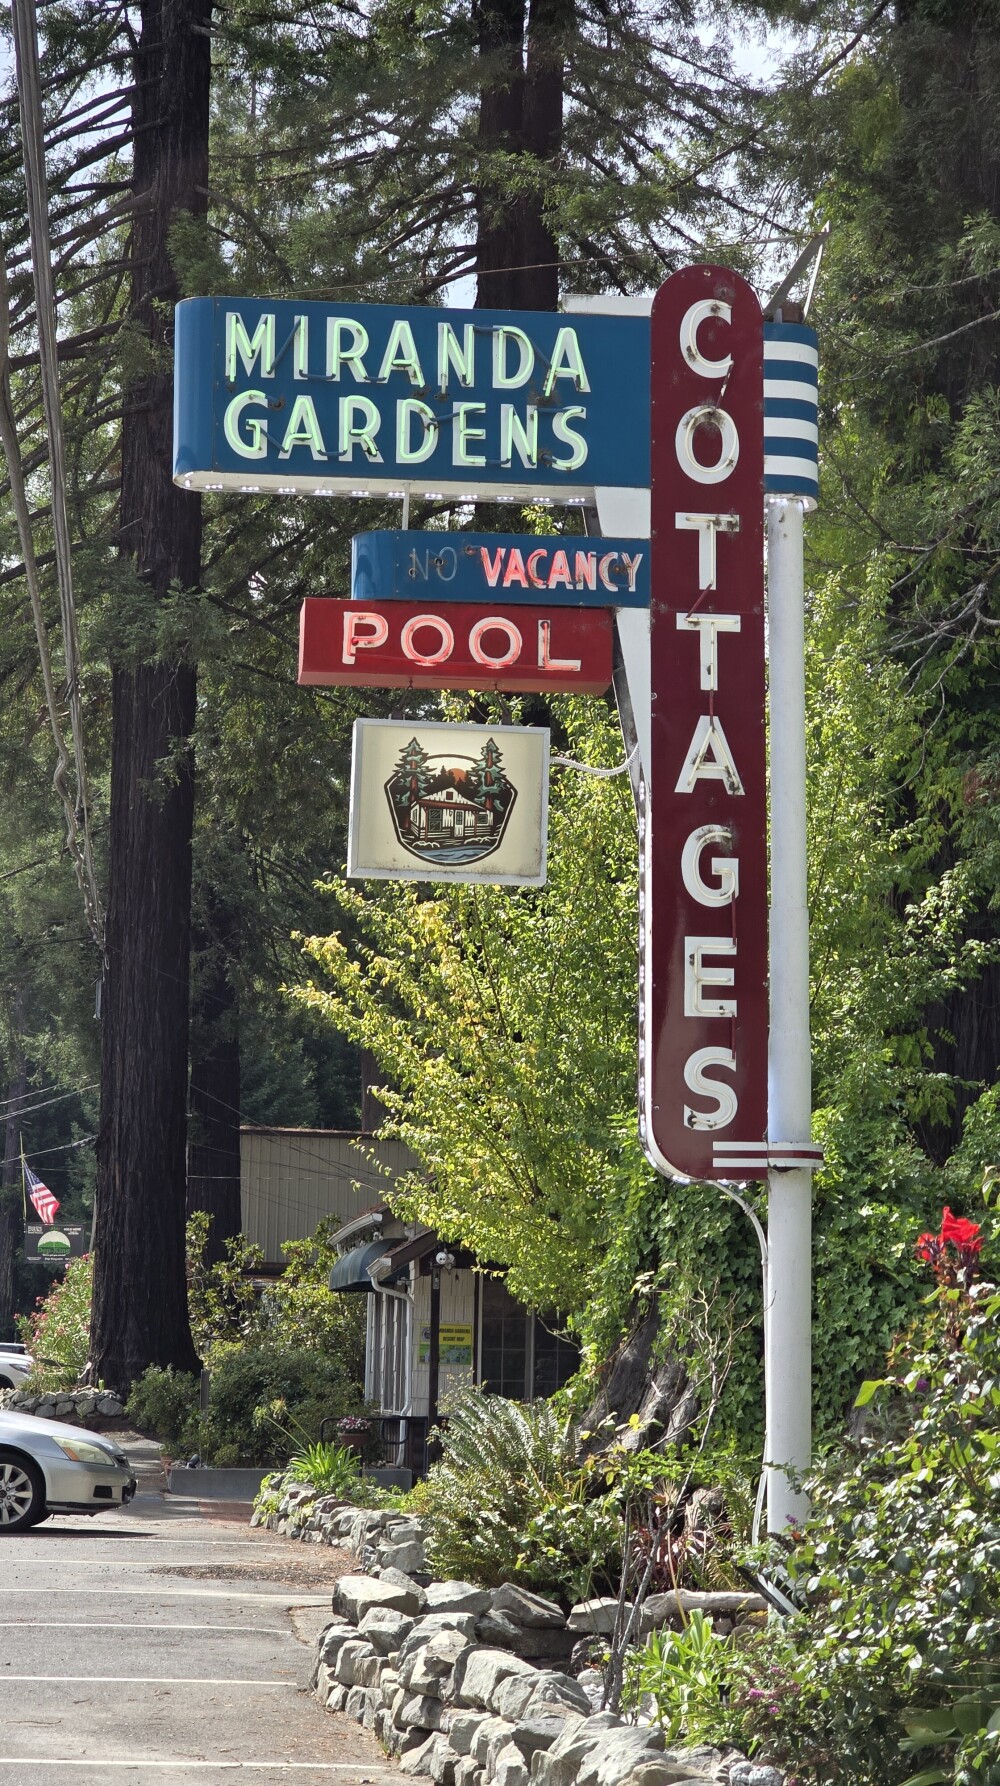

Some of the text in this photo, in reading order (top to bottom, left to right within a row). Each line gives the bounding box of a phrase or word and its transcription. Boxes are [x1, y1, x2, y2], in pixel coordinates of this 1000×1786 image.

[225, 312, 591, 396] MIRANDA
[223, 390, 588, 471] GARDENS
[409, 547, 643, 592] NO VACANCY
[342, 611, 581, 671] POOL
[675, 299, 745, 1131] COTTAGES
